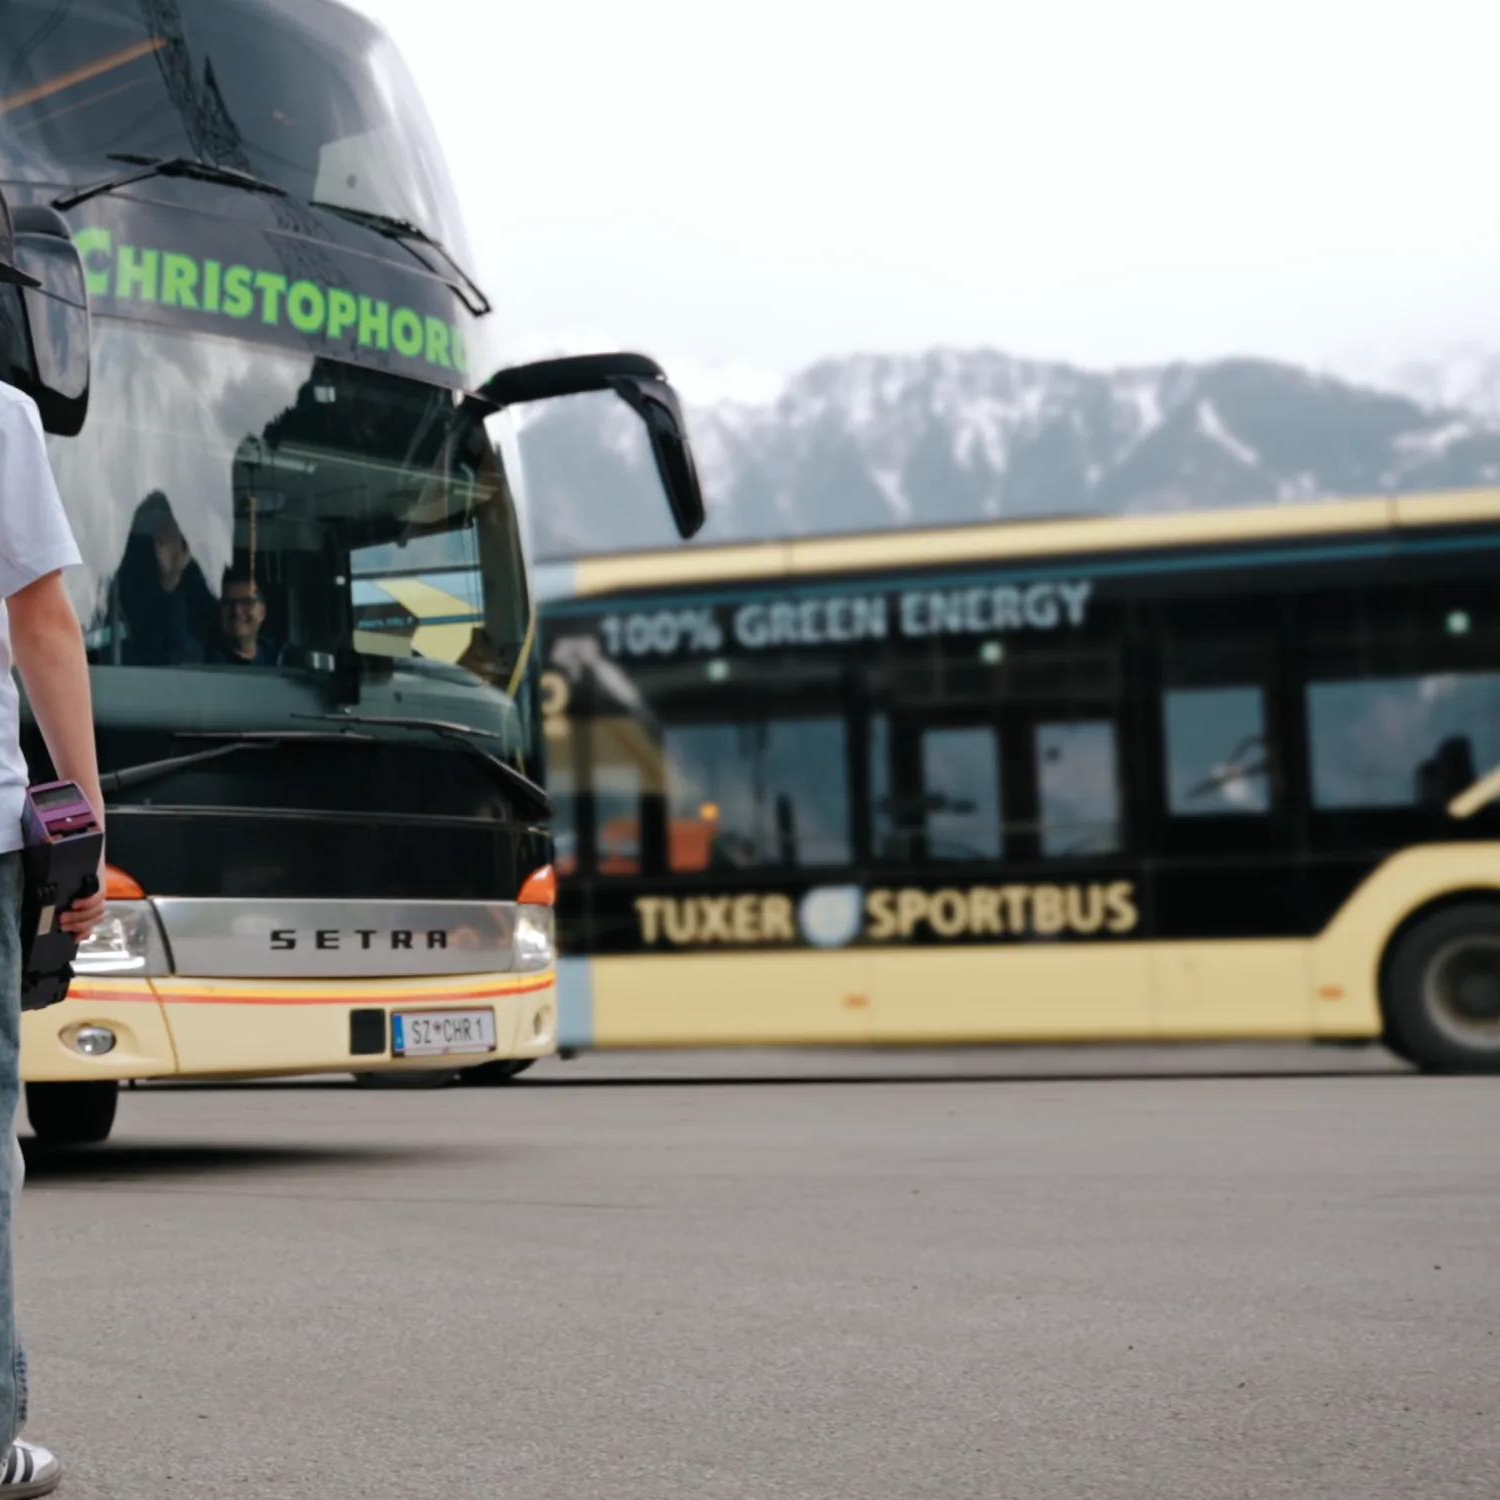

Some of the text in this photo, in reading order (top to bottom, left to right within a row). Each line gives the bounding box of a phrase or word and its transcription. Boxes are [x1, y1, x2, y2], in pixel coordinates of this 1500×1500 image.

[601, 580, 1092, 656] 100% GREEN ENERGY
[634, 881, 1140, 945] TUXER SPORTBUS
[270, 928, 449, 951] SETRA
[411, 1019, 432, 1045] SZ
[443, 1017, 473, 1043] CHR
